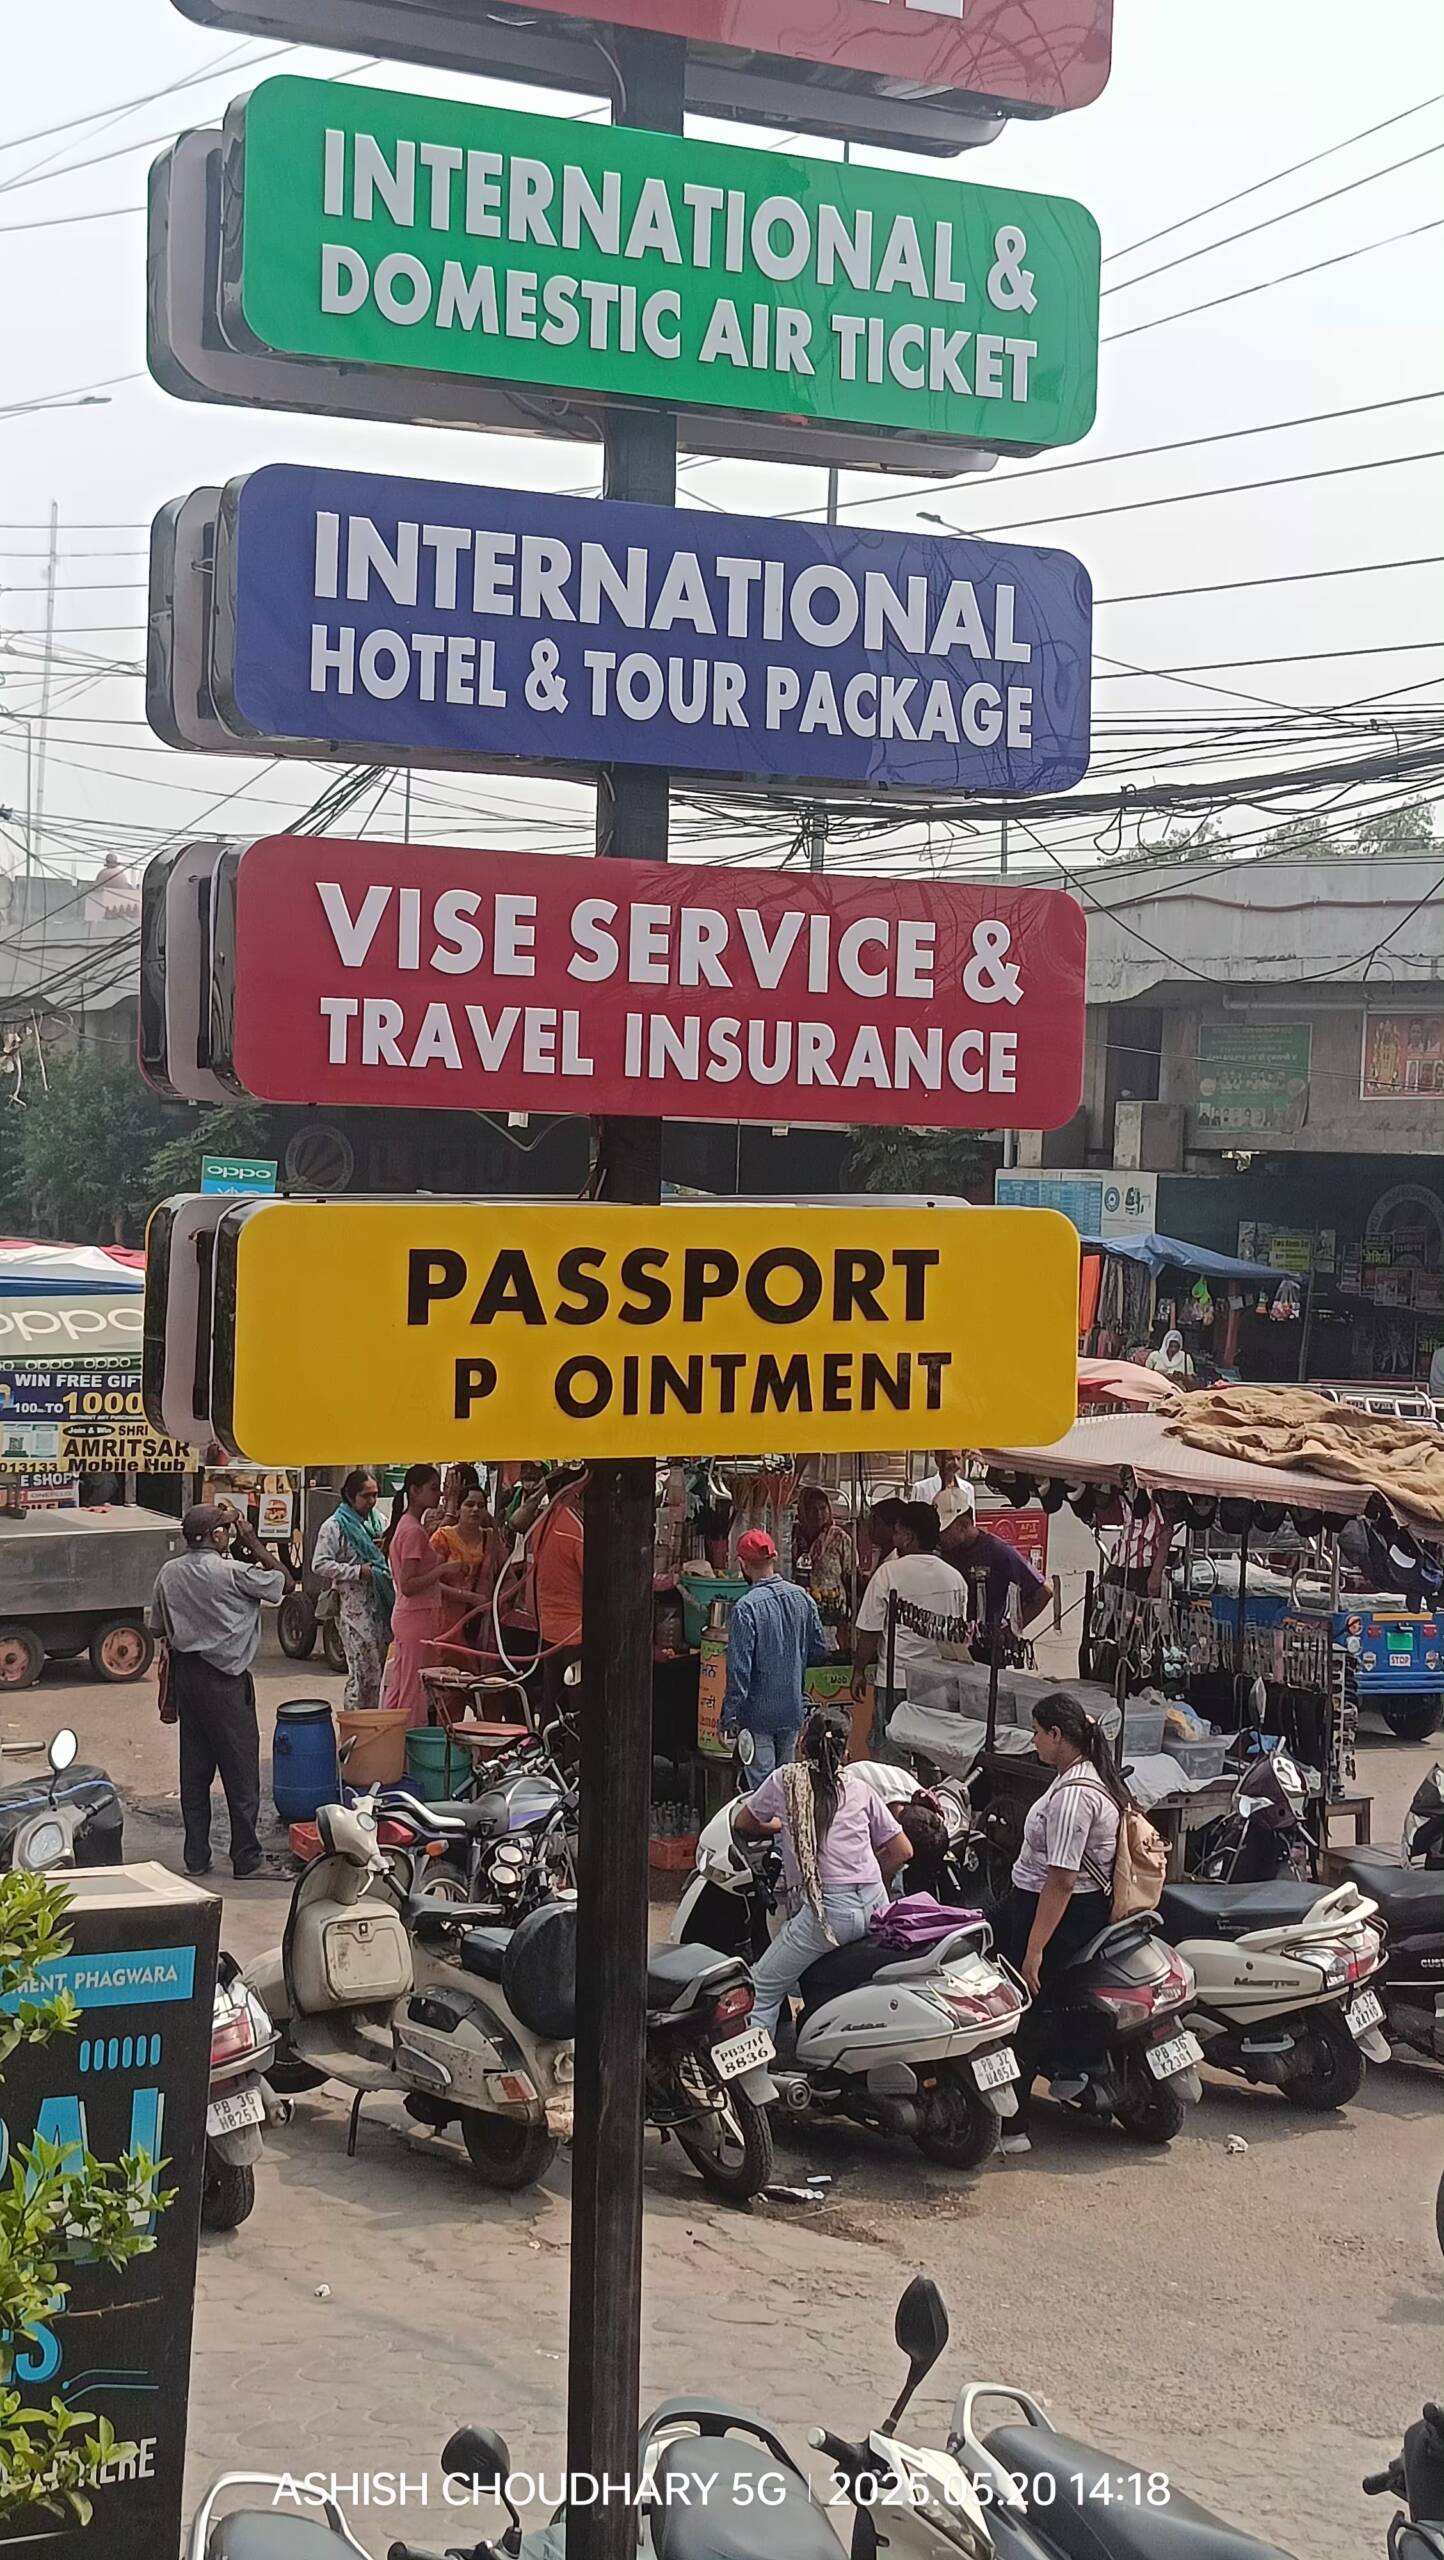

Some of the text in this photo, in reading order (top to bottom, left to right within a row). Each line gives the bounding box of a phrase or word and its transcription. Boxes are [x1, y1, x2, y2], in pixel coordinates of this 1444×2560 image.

[324, 129, 1038, 314] INTERNATIONAL &
[320, 243, 1038, 402] DOMESTIC AIR TICKET
[313, 510, 1032, 663] INTERNATIONAL
[310, 623, 1033, 749] HOTEL & TOUR PACKAGE
[315, 882, 1025, 1005] VISE SERVICE &
[320, 997, 1018, 1093] TRAVEL INSURANCE
[206, 1166, 272, 1179] oppo
[407, 1247, 940, 1326] PASSPORT
[14, 1374, 50, 1387] WIN
[56, 1375, 102, 1387] FREE
[118, 1425, 148, 1436] SHRI
[63, 1439, 190, 1458] AMRITSAR
[68, 1458, 186, 1472] Mobile Hub
[33, 1473, 73, 1486] SHOP
[1391, 1655, 1410, 1664] STOP
[75, 1965, 178, 1989] PHAGWARA
[725, 2047, 768, 2073] 8836
[1154, 2046, 1170, 2062] PB
[213, 2100, 231, 2116] PB
